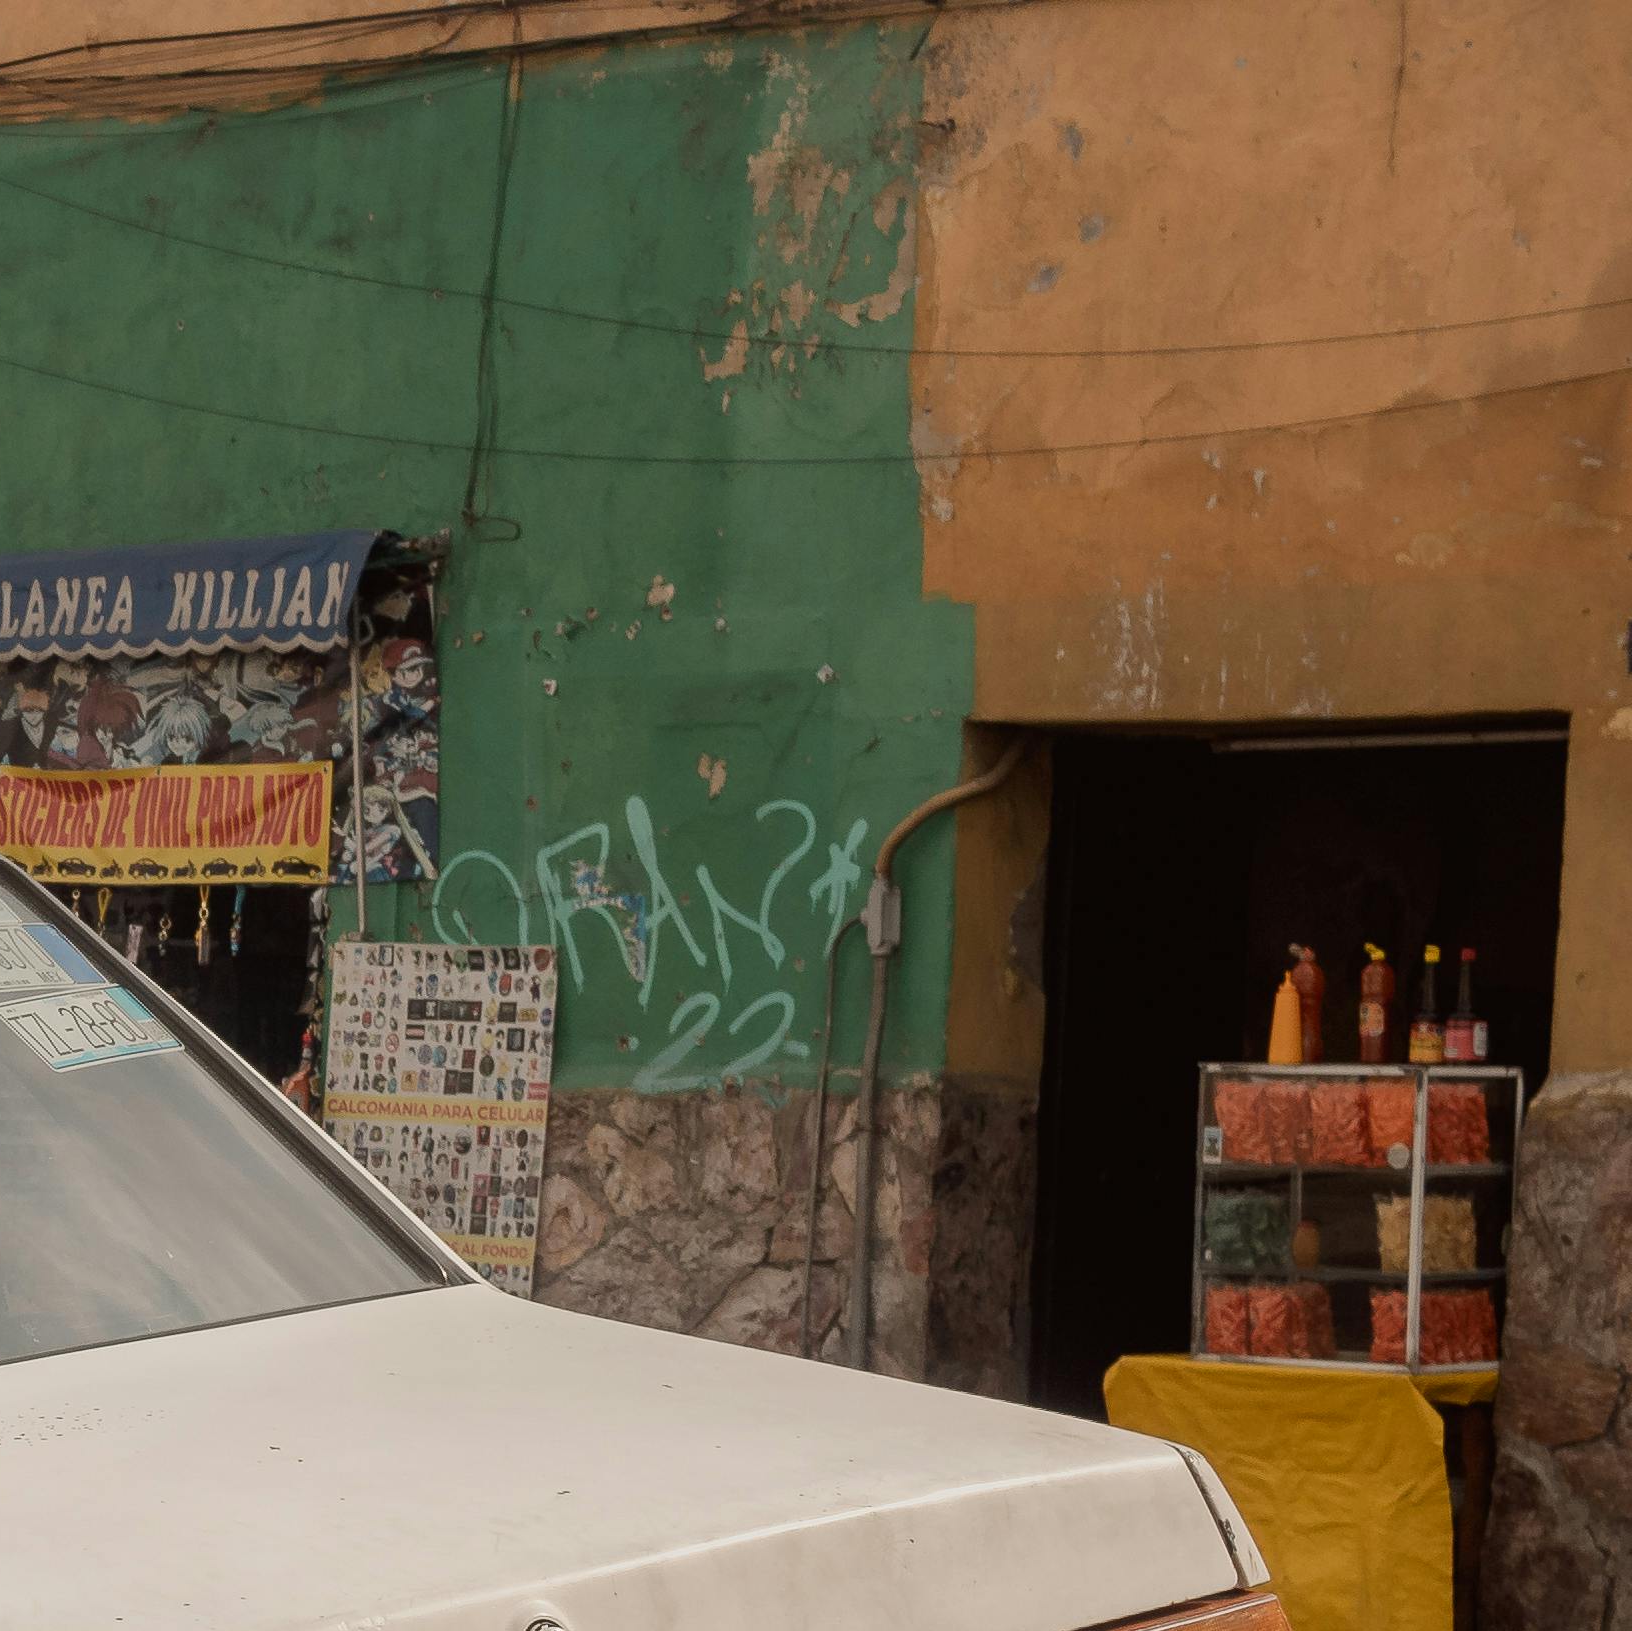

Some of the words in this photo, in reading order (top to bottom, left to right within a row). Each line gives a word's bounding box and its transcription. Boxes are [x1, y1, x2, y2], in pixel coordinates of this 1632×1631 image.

[166, 561, 350, 632] KILLIAN
[100, 778, 136, 848] DE
[134, 776, 192, 848] VINIL
[196, 775, 258, 848] PARA
[255, 771, 324, 848] AUTO
[7, 999, 150, 1059] TZL-28-80
[327, 1098, 428, 1118] CALCOMANIA
[432, 1103, 473, 1120] PARA
[477, 1105, 545, 1124] CELULAR
[481, 1244, 528, 1260] FONDO
